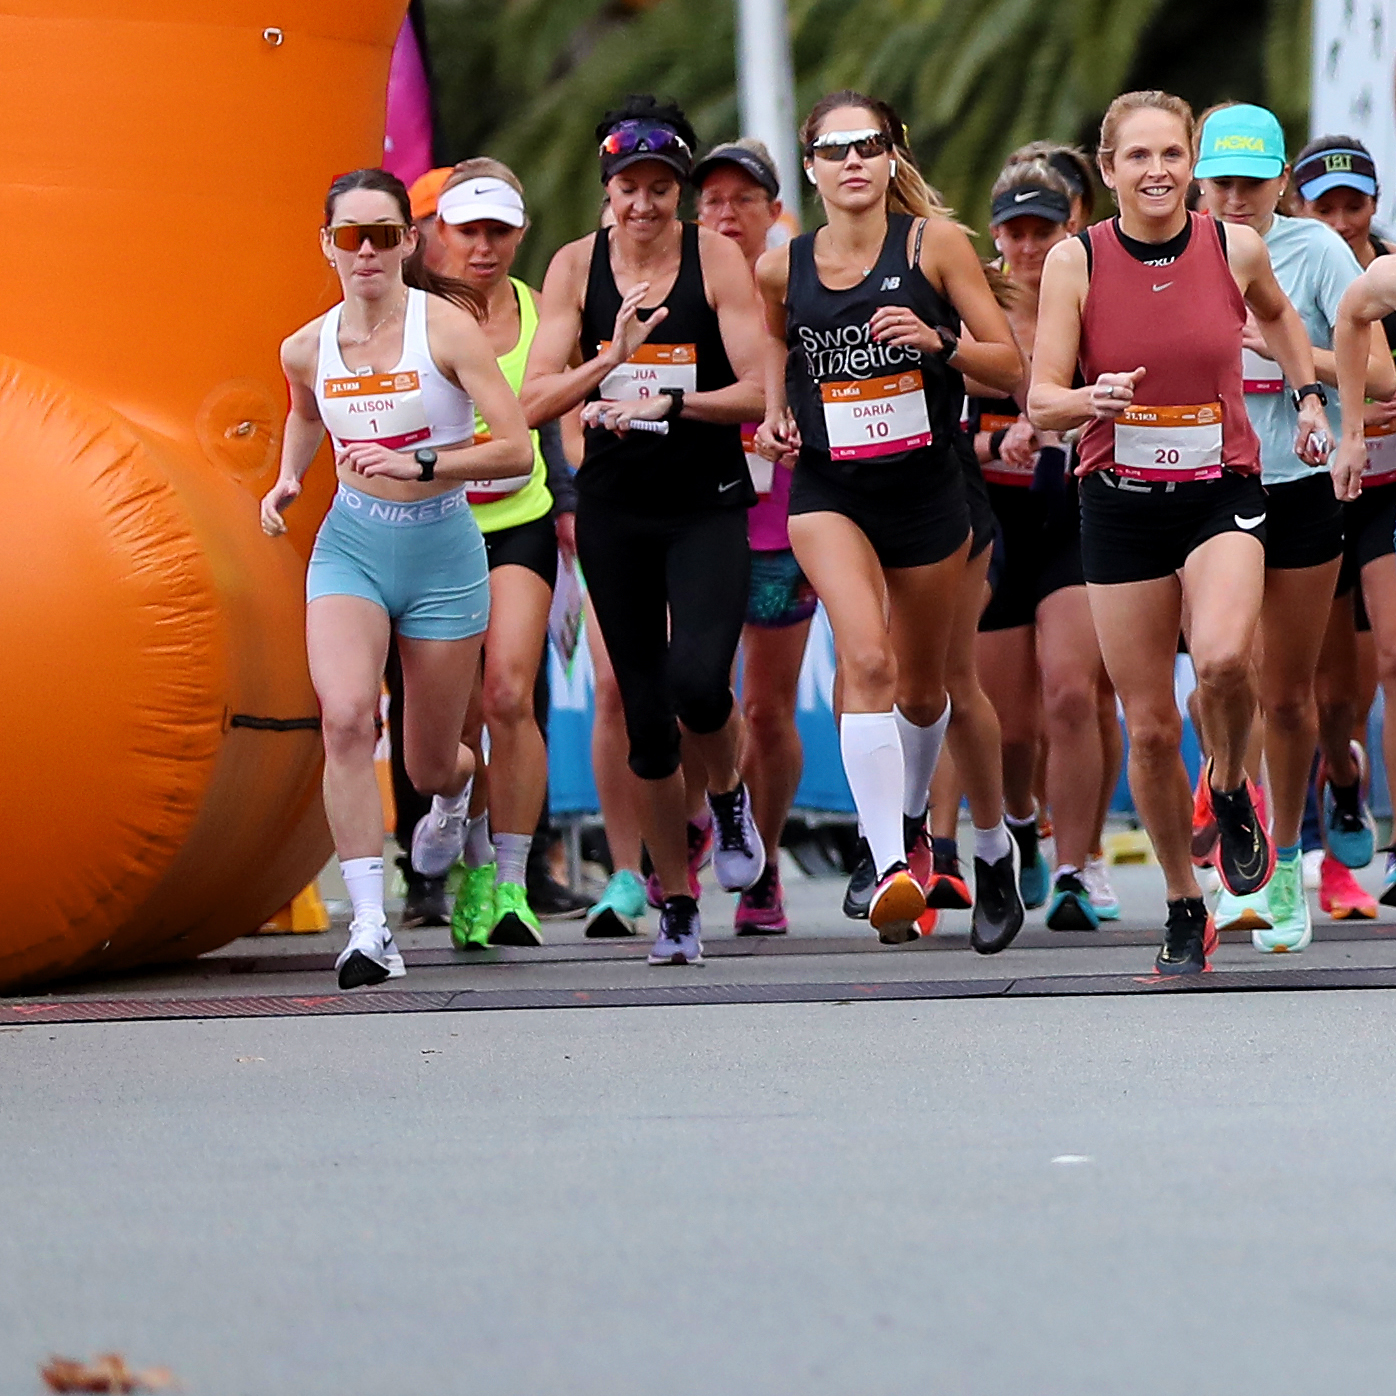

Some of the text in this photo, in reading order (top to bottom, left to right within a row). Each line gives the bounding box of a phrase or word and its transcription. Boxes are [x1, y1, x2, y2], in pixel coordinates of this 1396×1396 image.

[1214, 135, 1265, 152] HOKA
[880, 277, 900, 291] NB
[632, 370, 658, 380] JUA
[332, 382, 360, 392] 21.1KM
[348, 400, 394, 414] ALISON
[853, 403, 895, 418] DARIA
[1125, 411, 1158, 421] 21.1KM
[368, 419, 379, 434] 1
[865, 422, 889, 438] 10
[1155, 449, 1180, 464] 20
[369, 500, 435, 522] NIKE
